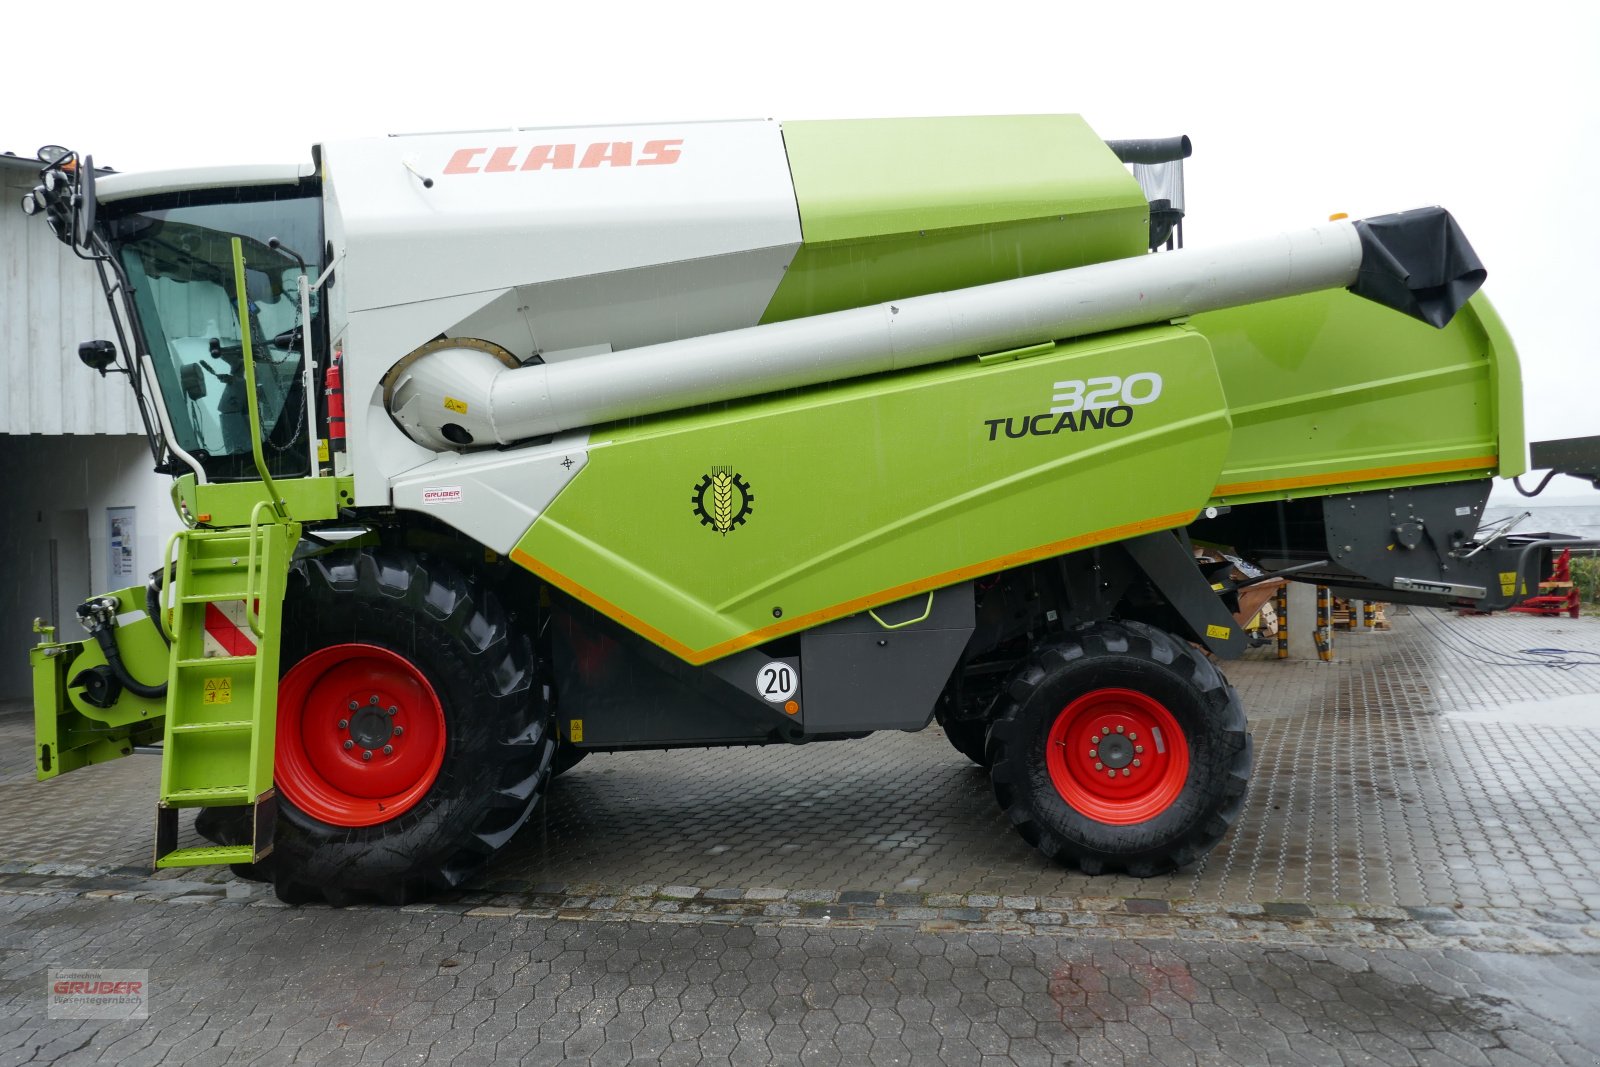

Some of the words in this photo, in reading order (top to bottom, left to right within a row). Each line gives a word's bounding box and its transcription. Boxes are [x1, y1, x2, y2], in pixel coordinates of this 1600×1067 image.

[443, 139, 684, 175] CLAAS
[1050, 371, 1163, 414] 320
[984, 405, 1134, 442] TUCANO
[424, 490, 460, 498] GRUBER
[764, 667, 790, 694] 20
